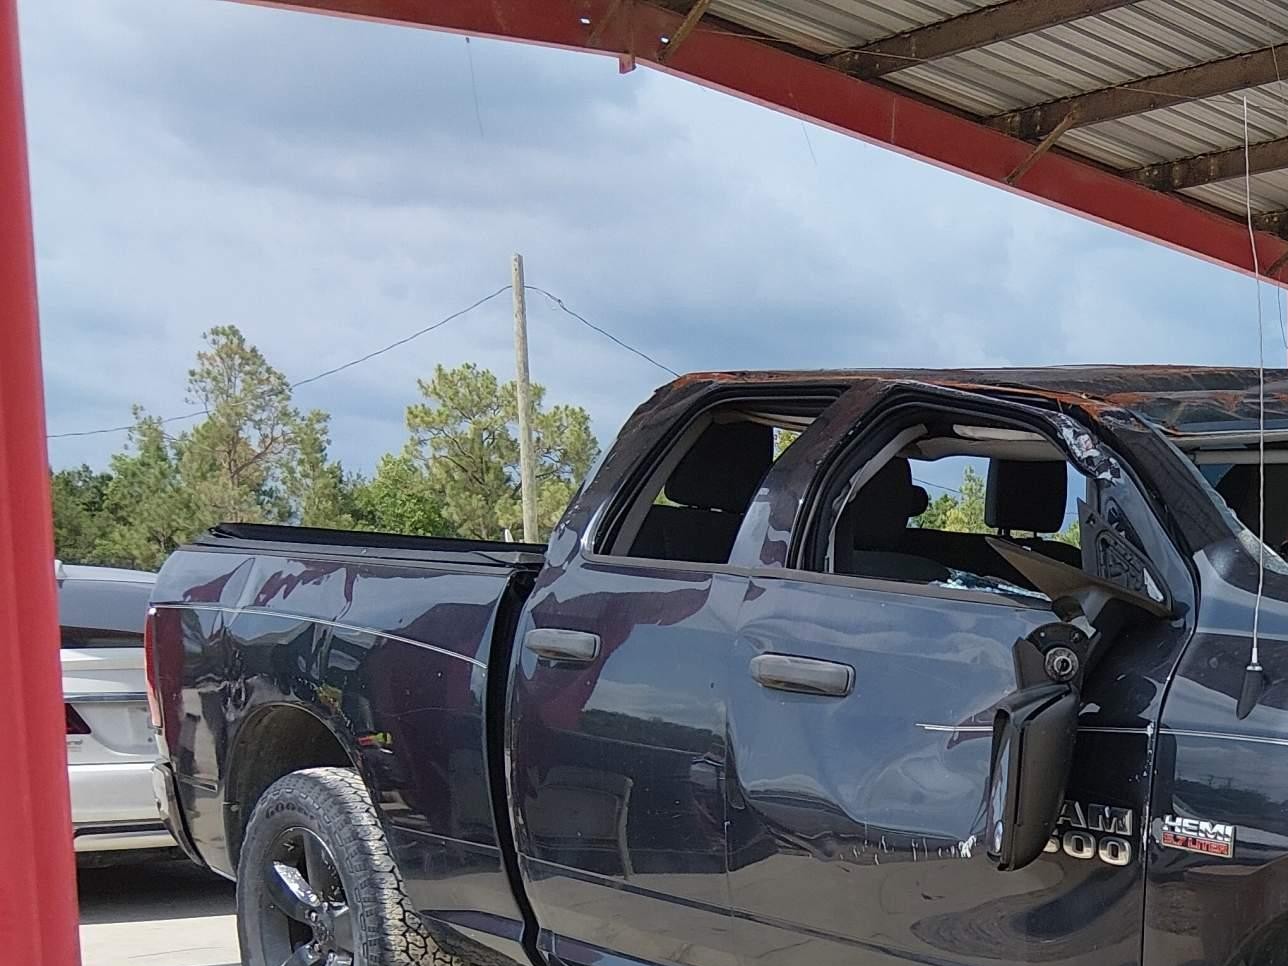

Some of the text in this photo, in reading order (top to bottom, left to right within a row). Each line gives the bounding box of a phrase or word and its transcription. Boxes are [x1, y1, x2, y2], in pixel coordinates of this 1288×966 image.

[1057, 800, 1132, 836] AM
[1162, 814, 1234, 842] HEMI
[1043, 829, 1132, 866] 00
[1187, 837, 1230, 856] LITER
